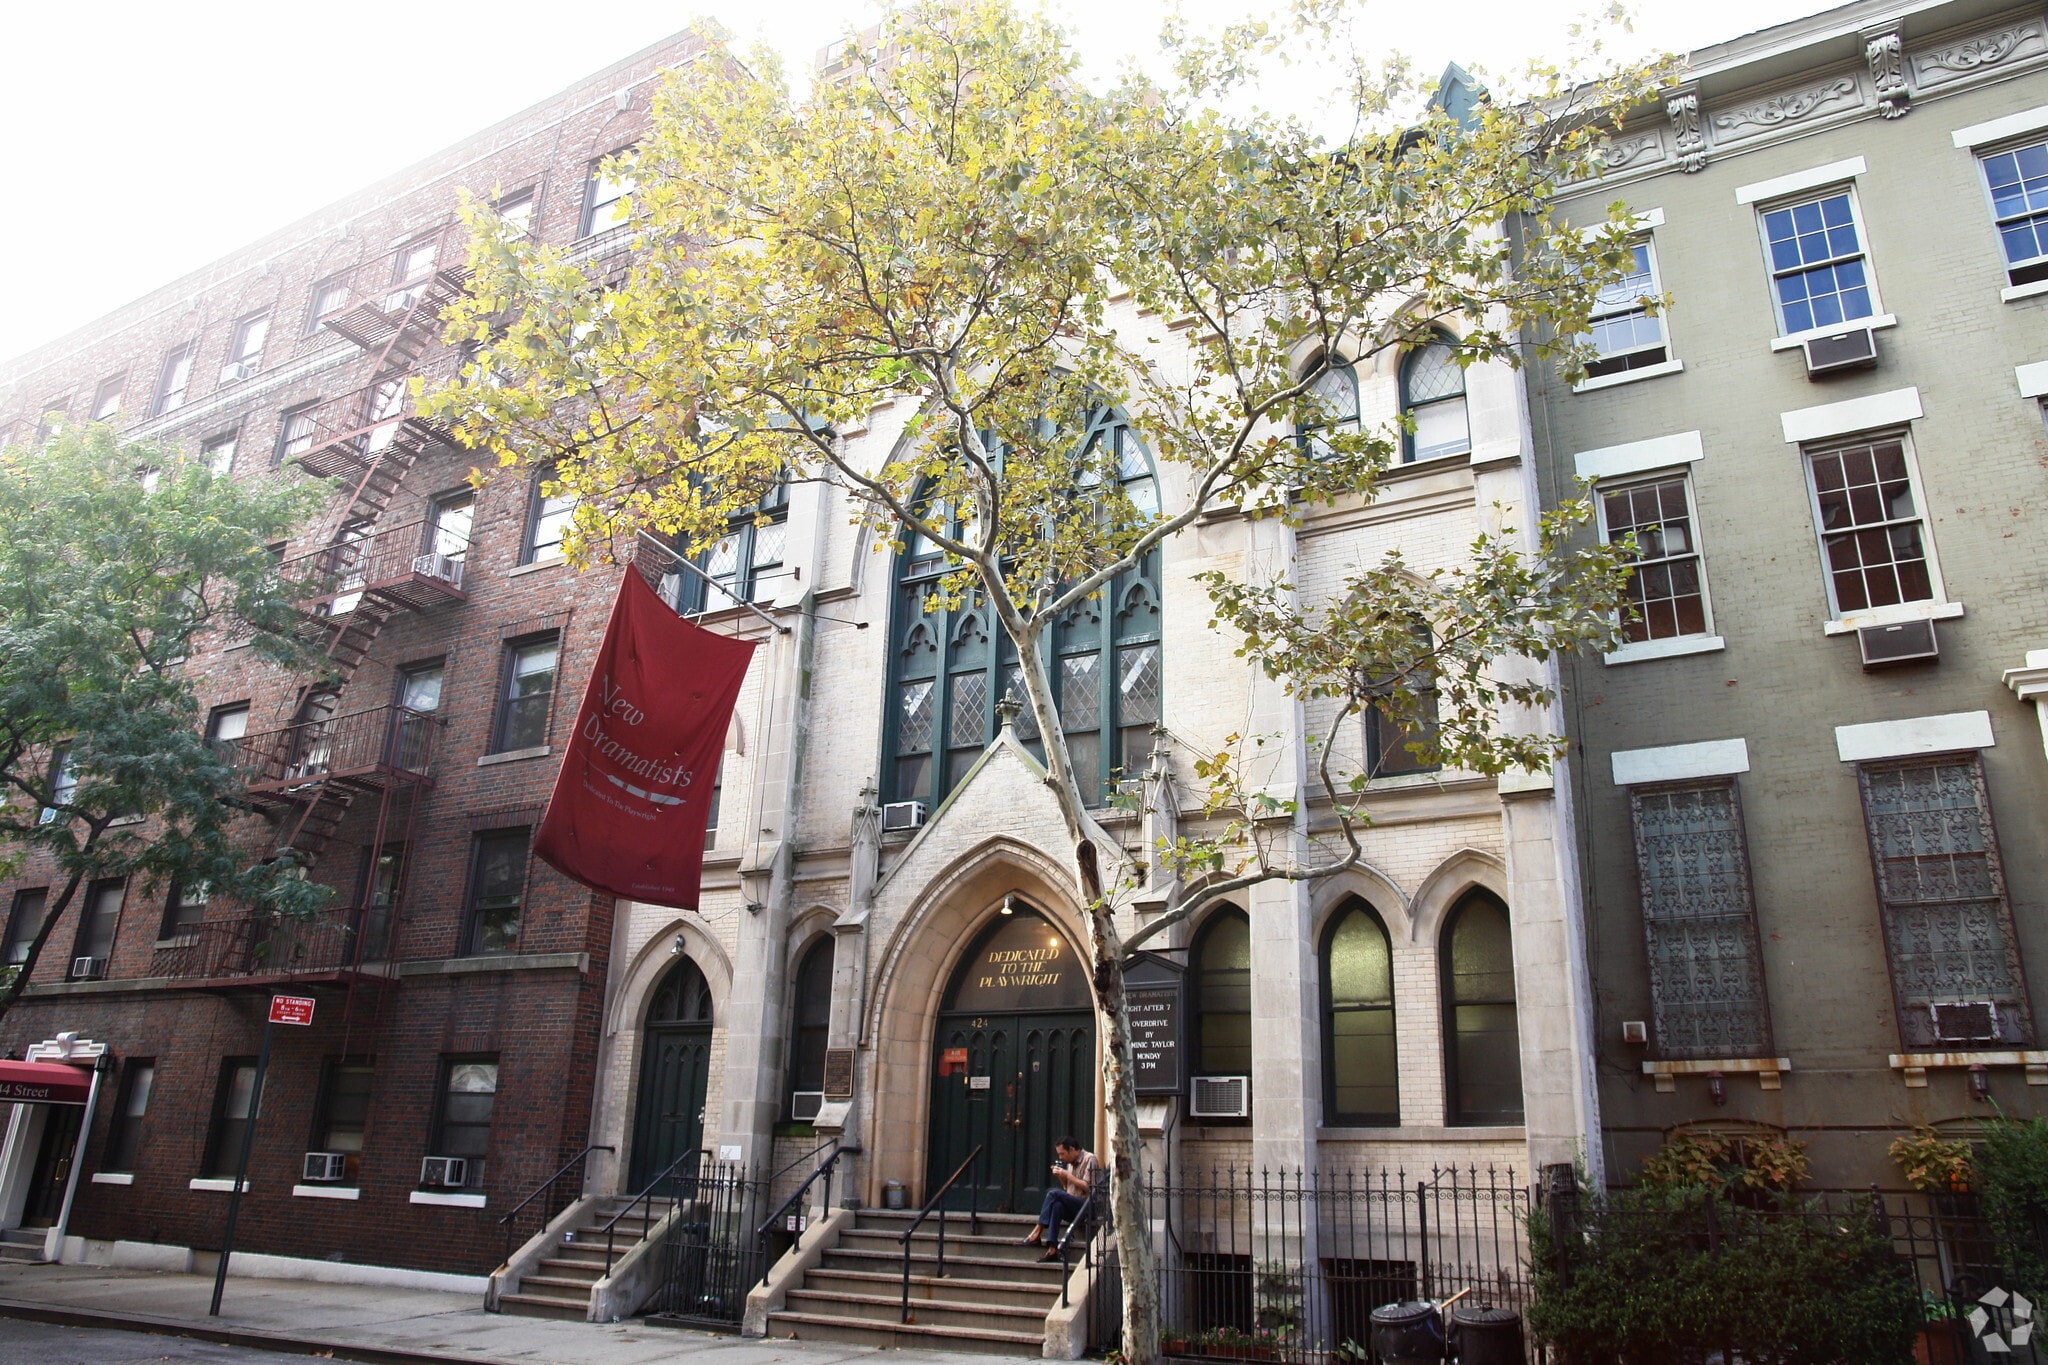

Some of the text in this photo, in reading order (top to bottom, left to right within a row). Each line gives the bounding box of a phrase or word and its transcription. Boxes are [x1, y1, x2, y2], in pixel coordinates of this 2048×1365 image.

[598, 674, 644, 726] New
[583, 711, 693, 787] Dramatists
[615, 800, 624, 809] The
[624, 804, 656, 821] Playwright
[989, 948, 1060, 963] DEDICATED
[1001, 961, 1047, 974] TO THE
[979, 973, 1063, 988] PLAYWRIGHT
[286, 999, 312, 1007] STANDING
[1143, 1004, 1164, 1012] AFTER
[971, 1018, 988, 1028] 424
[1131, 1019, 1168, 1028] OVERDRIVE
[1151, 1040, 1175, 1048] TAYLOR
[1136, 1052, 1161, 1060] MONDAY
[14, 1084, 49, 1098] Street
